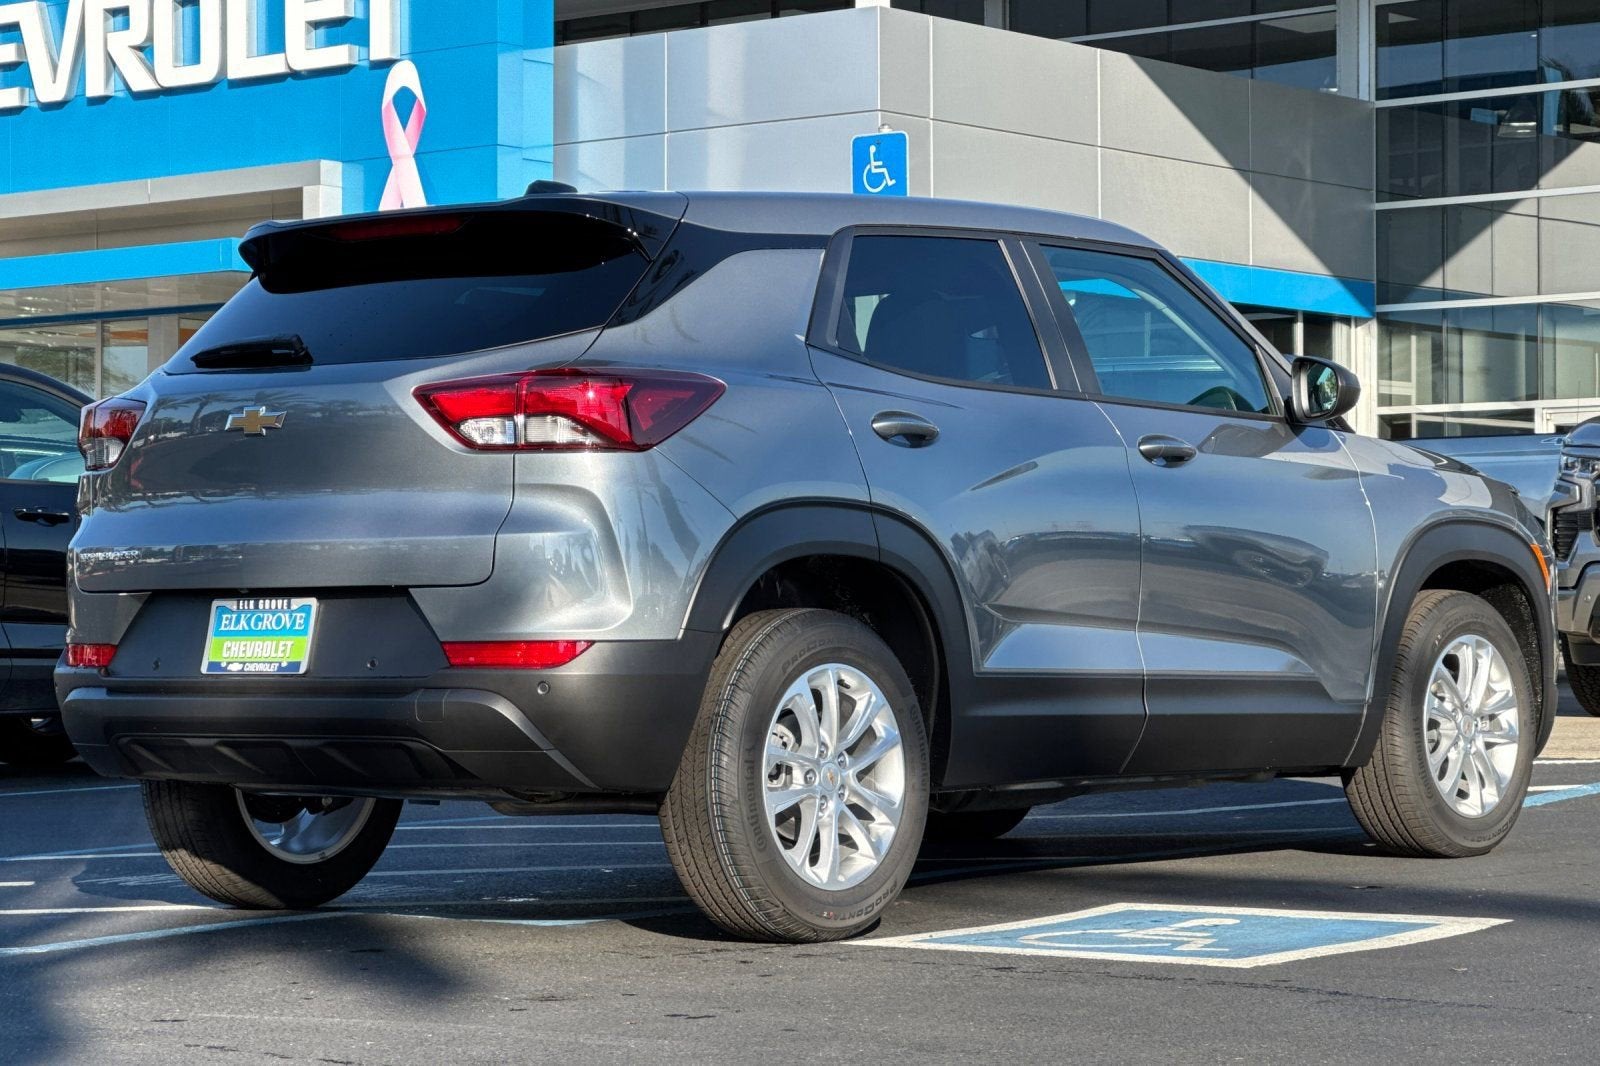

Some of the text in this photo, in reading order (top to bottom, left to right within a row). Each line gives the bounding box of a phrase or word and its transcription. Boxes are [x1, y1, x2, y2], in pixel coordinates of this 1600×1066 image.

[239, 599, 288, 609] ELK GROVE
[222, 641, 293, 658] CHEVROLET
[243, 662, 279, 671] CHEVROLET
